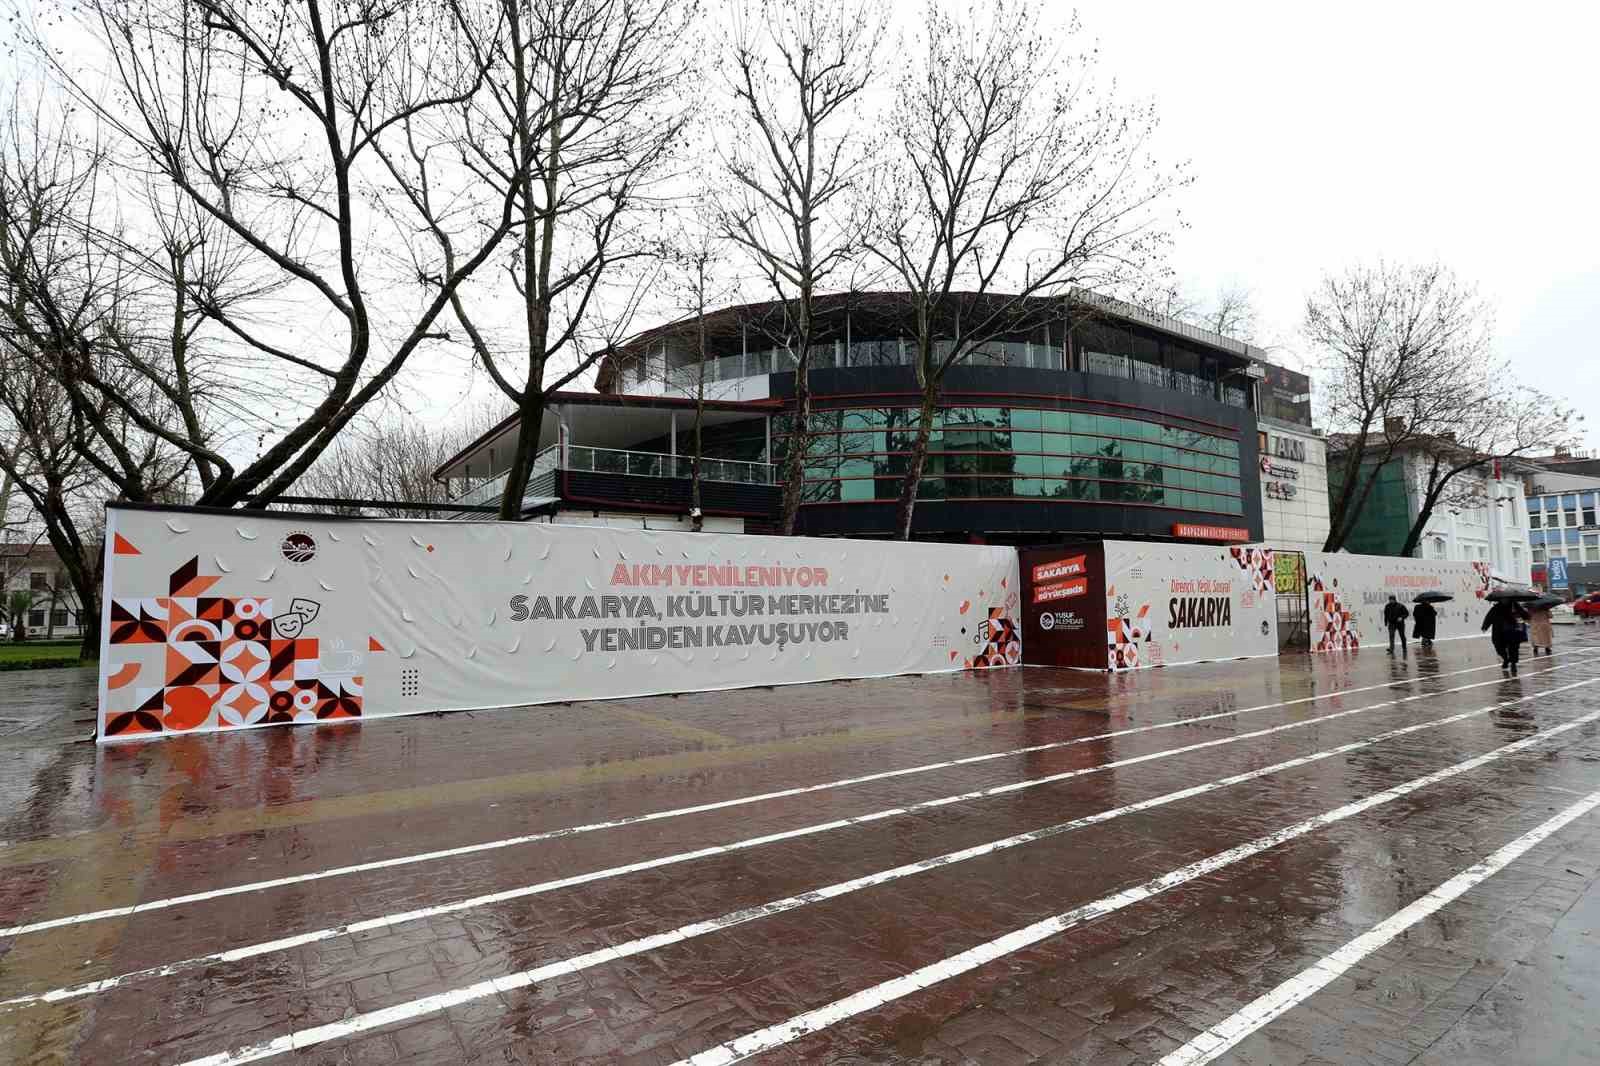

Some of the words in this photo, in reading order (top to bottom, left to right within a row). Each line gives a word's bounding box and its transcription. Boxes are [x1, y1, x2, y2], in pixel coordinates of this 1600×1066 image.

[610, 563, 673, 586] AKM
[675, 560, 829, 587] YENİLENİYOR
[1037, 563, 1080, 580] SAKARYA
[509, 594, 663, 622] SAKARYA,
[666, 590, 765, 618] KÜLTÜR
[1168, 597, 1232, 629] SAKARYA
[580, 620, 703, 652] YENİDEN
[706, 621, 849, 652] KAVUŞUYOR
